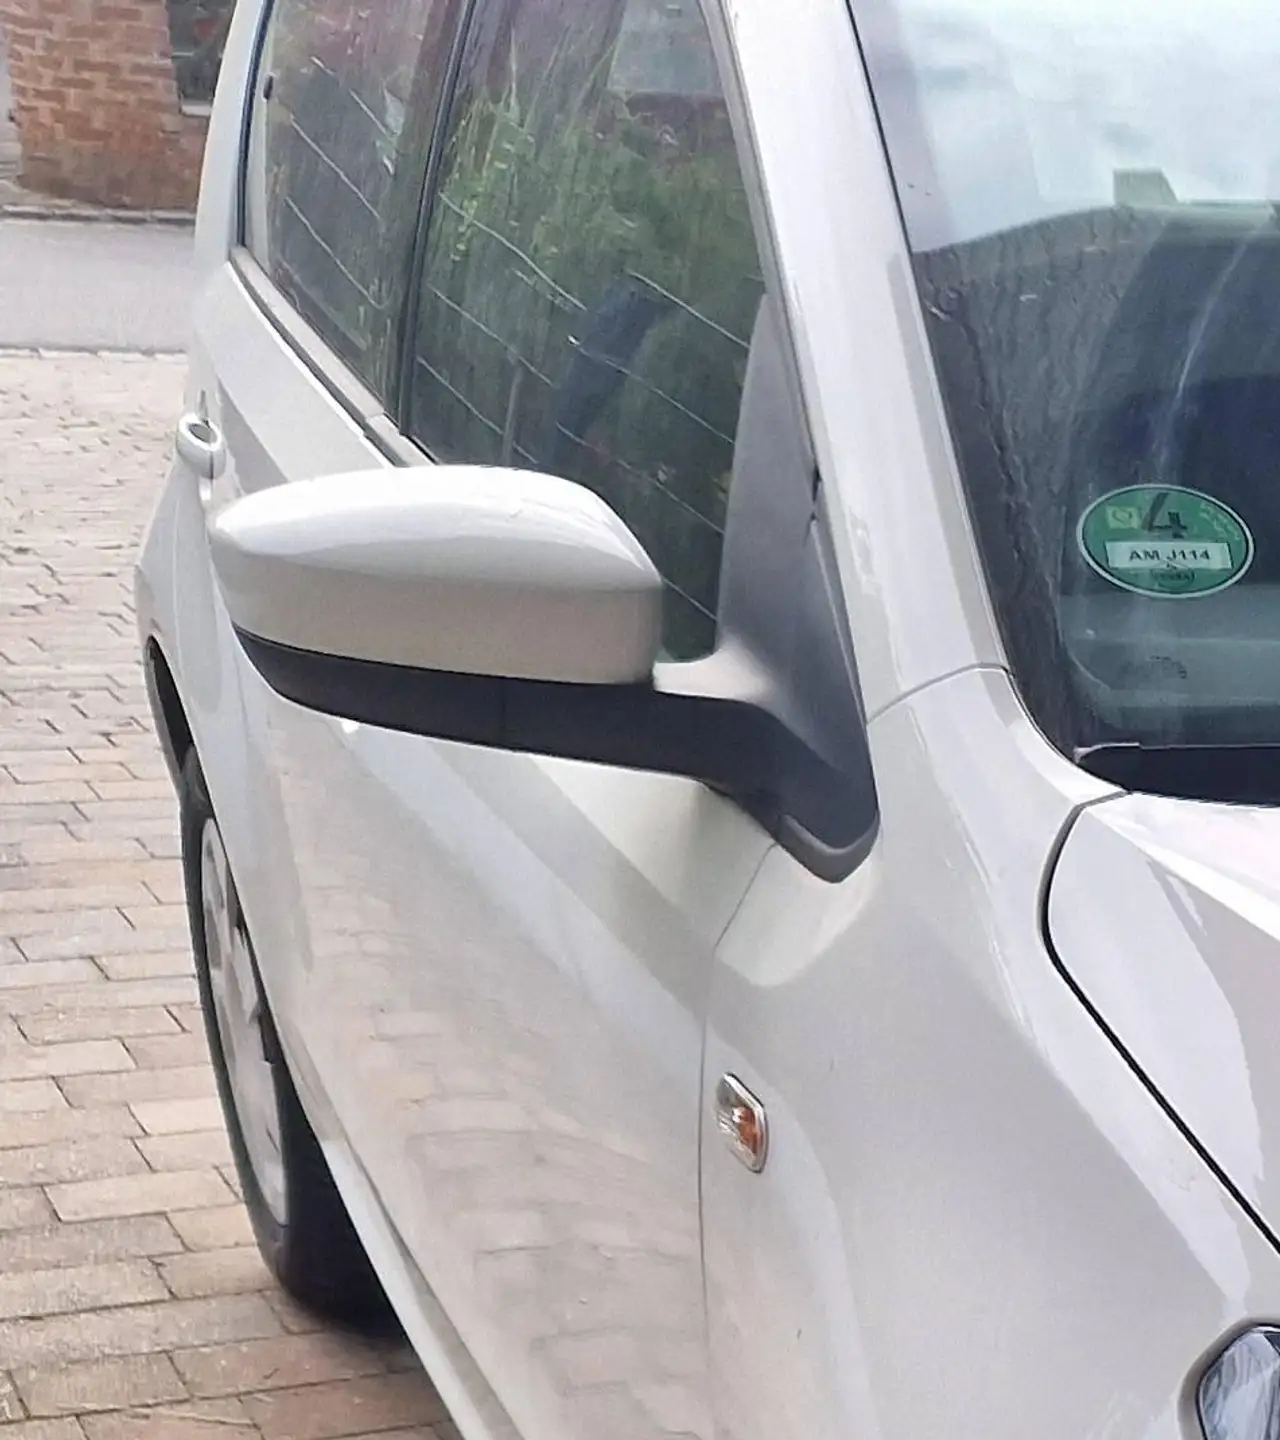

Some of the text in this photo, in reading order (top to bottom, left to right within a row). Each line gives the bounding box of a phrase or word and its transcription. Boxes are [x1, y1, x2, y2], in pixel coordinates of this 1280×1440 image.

[1141, 492, 1188, 539] 4
[1129, 549, 1210, 562] AM J114
